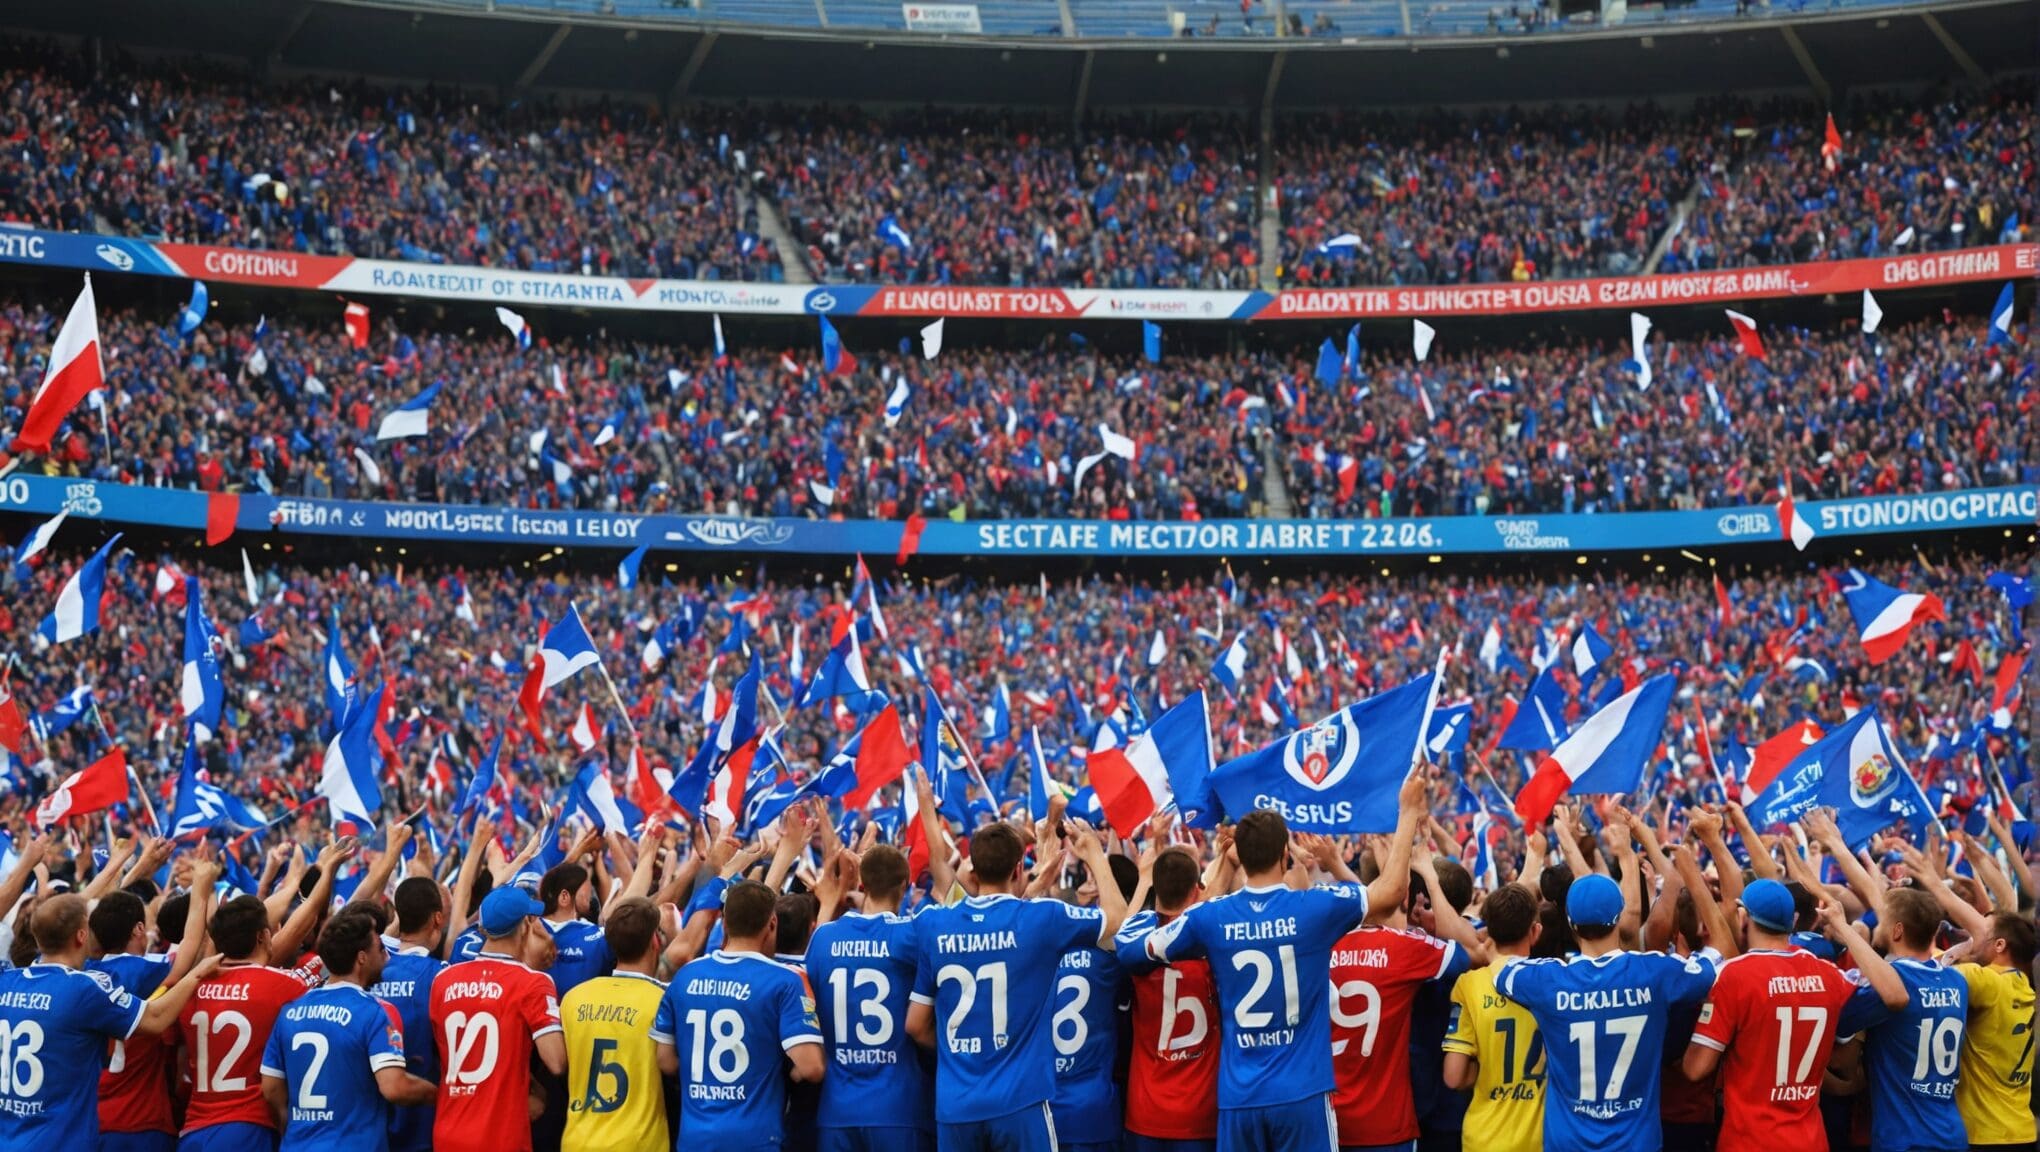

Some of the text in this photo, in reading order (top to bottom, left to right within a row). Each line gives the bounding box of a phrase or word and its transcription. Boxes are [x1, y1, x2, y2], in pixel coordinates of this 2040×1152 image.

[829, 967, 894, 1046] 13
[1231, 944, 1300, 1028] 21
[191, 1010, 252, 1093] 12
[291, 1031, 329, 1108] 2
[686, 1008, 750, 1084] 18
[1569, 1014, 1648, 1102] 17
[1775, 1006, 1829, 1087] 17
